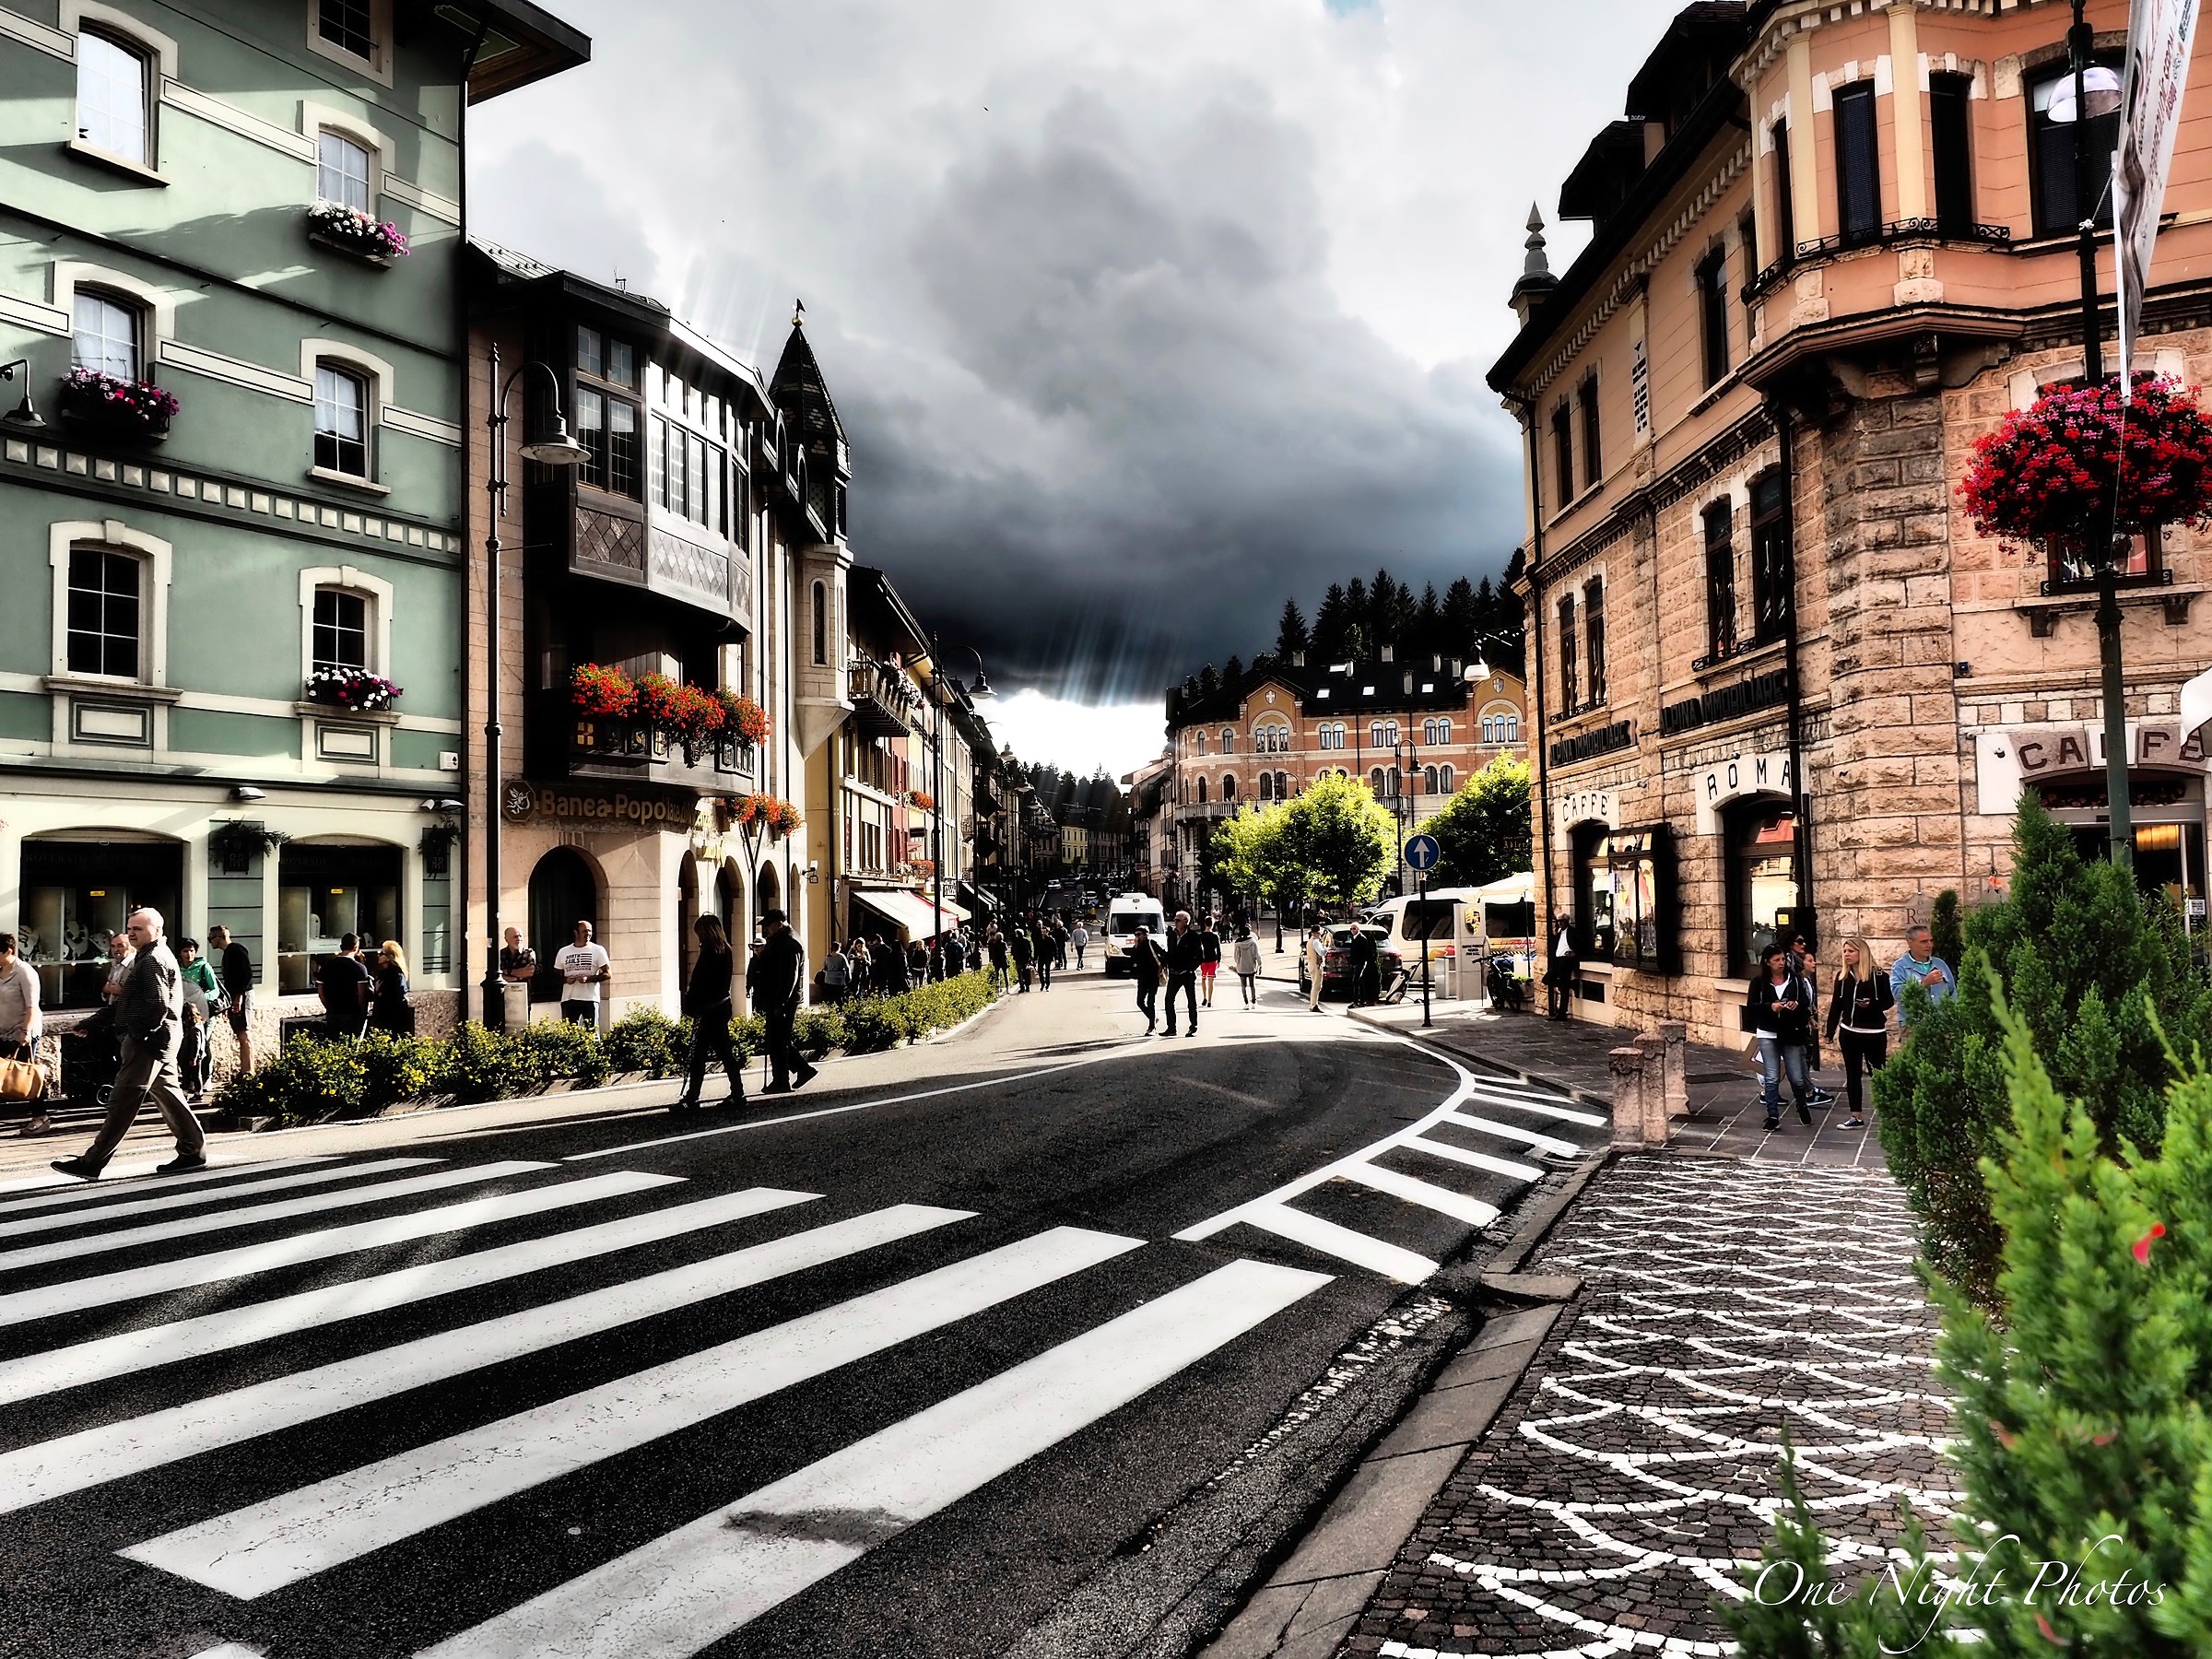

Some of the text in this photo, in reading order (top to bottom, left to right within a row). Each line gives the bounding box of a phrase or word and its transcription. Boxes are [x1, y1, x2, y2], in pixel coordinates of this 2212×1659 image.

[1660, 671, 1783, 735] ALPINA IMMOBILIARE
[1550, 721, 1628, 766] ALPINA IMMOBILIARE
[1706, 758, 1792, 800] ROMA
